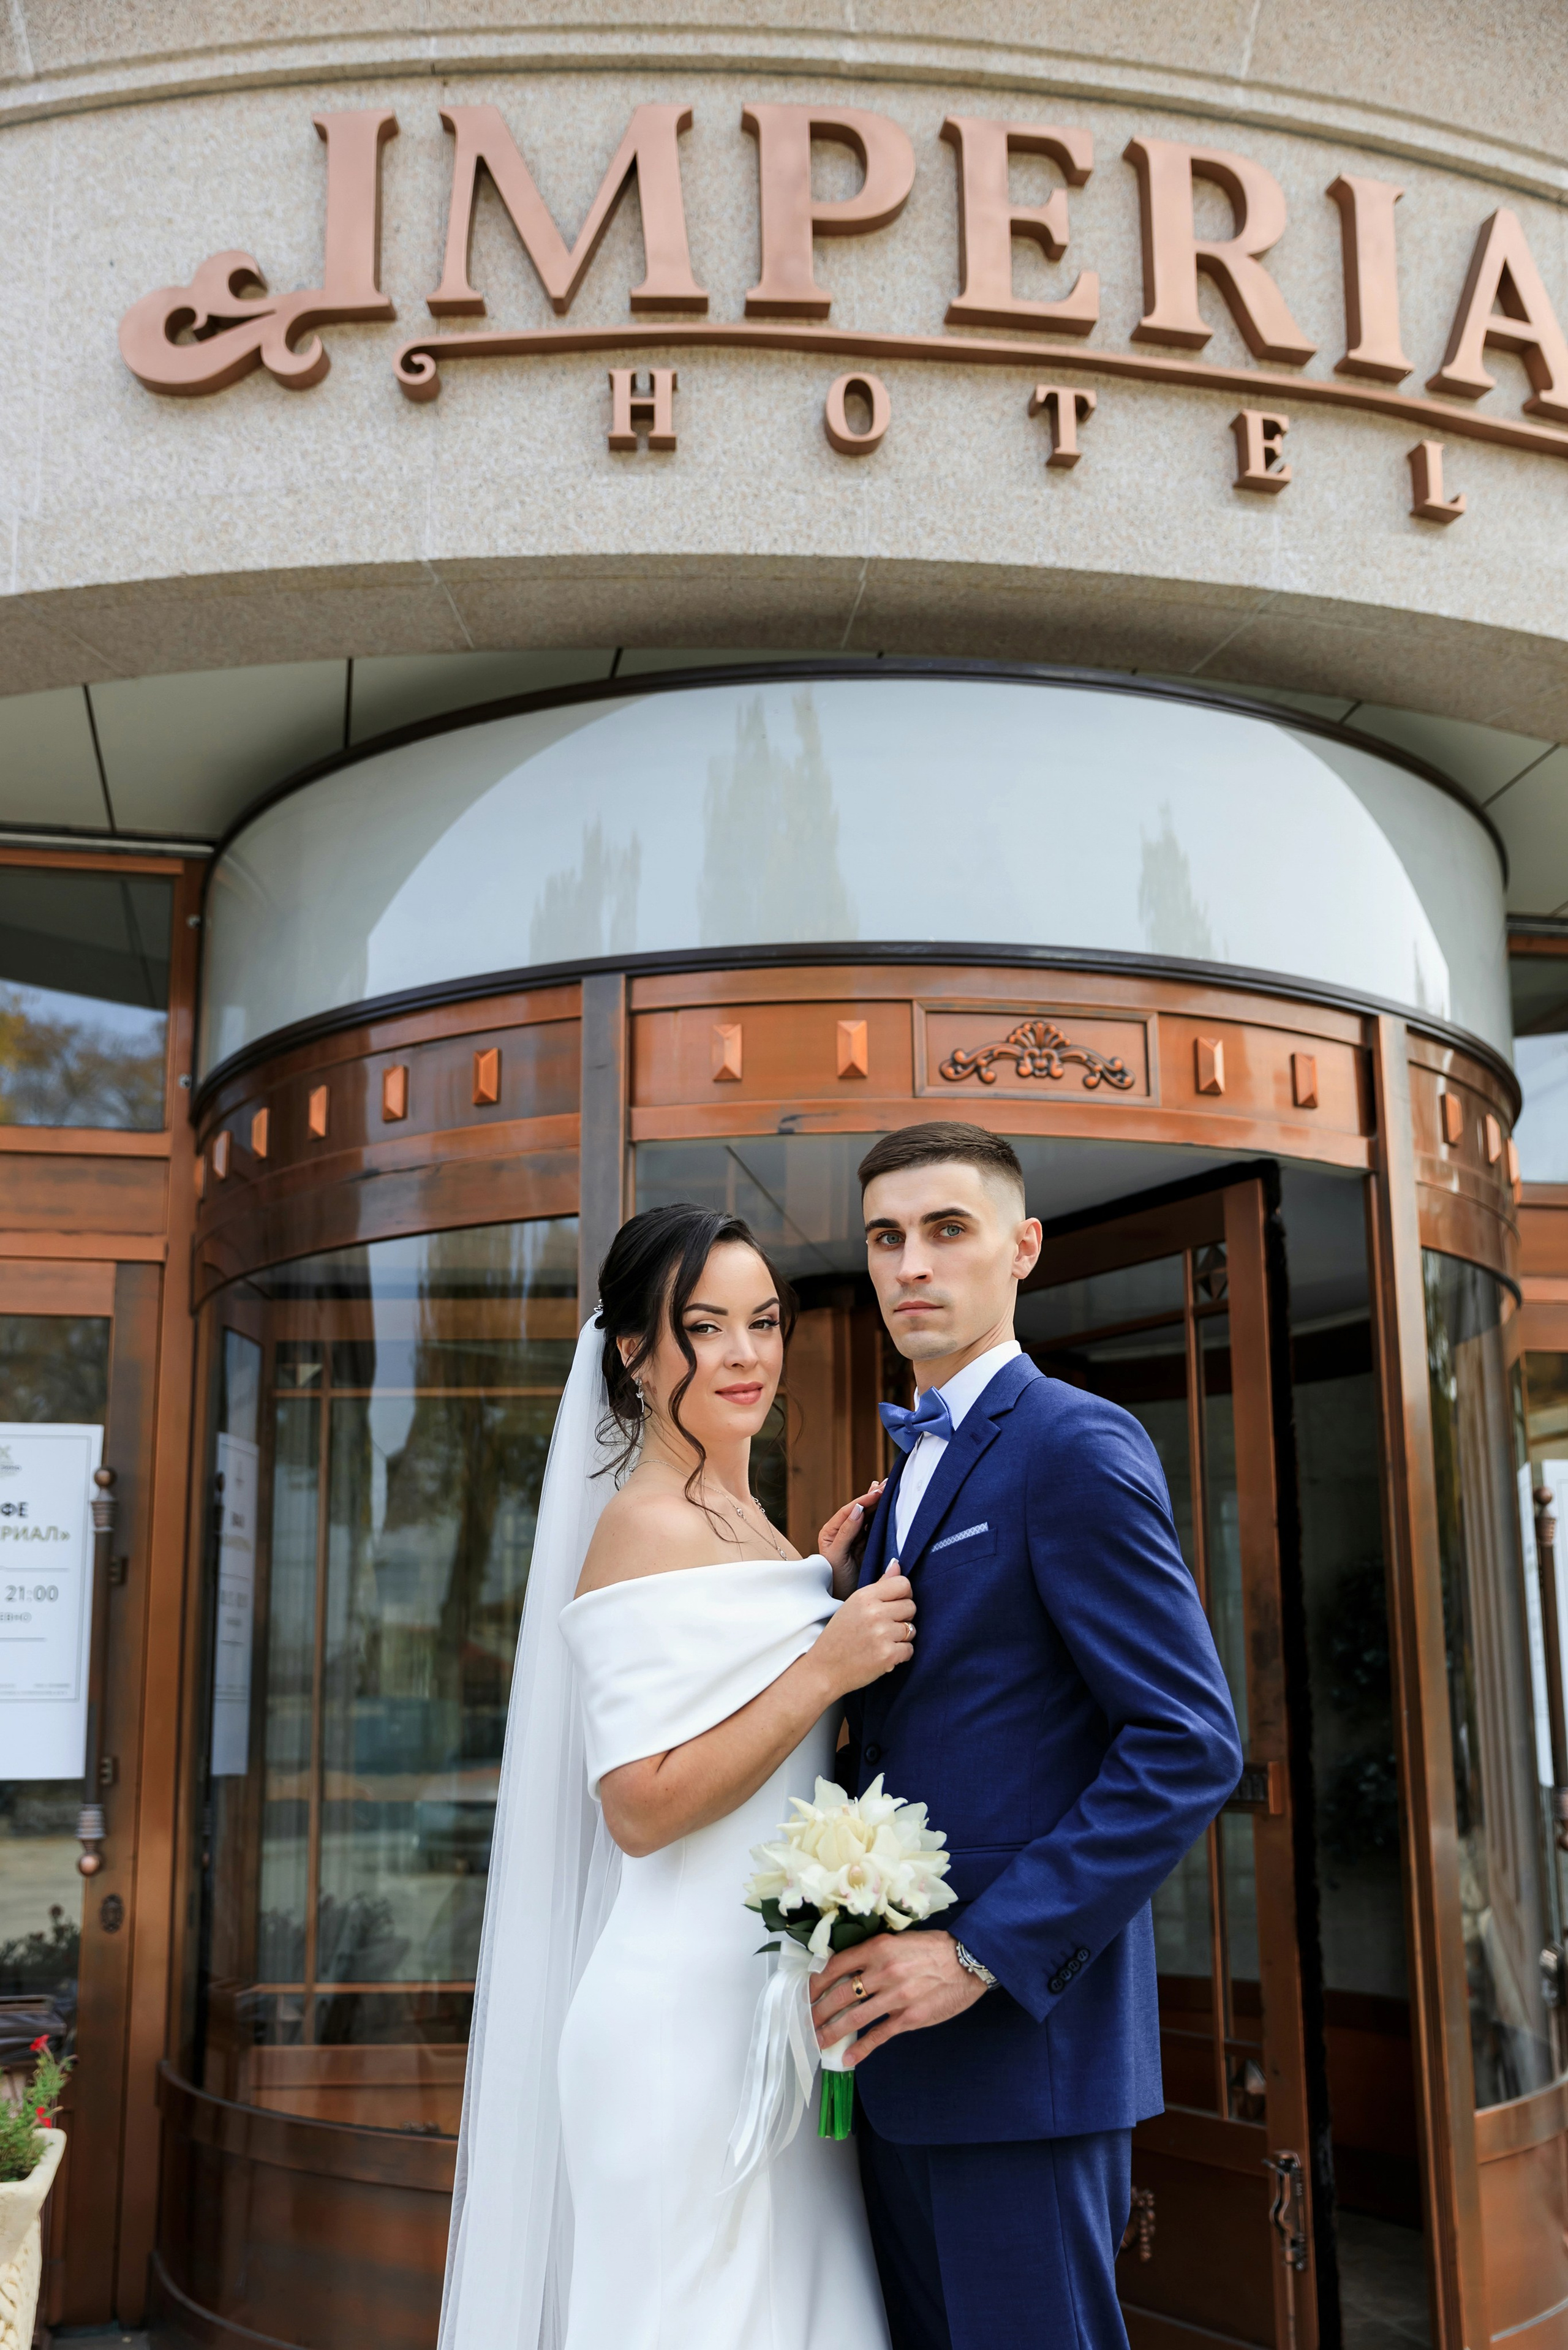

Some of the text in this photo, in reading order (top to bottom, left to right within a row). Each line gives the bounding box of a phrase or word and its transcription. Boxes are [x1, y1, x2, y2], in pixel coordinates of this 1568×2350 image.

[311, 104, 1568, 423] IMPERIA
[608, 369, 1466, 525] HOTEL
[6, 1584, 59, 1602] 21:00
